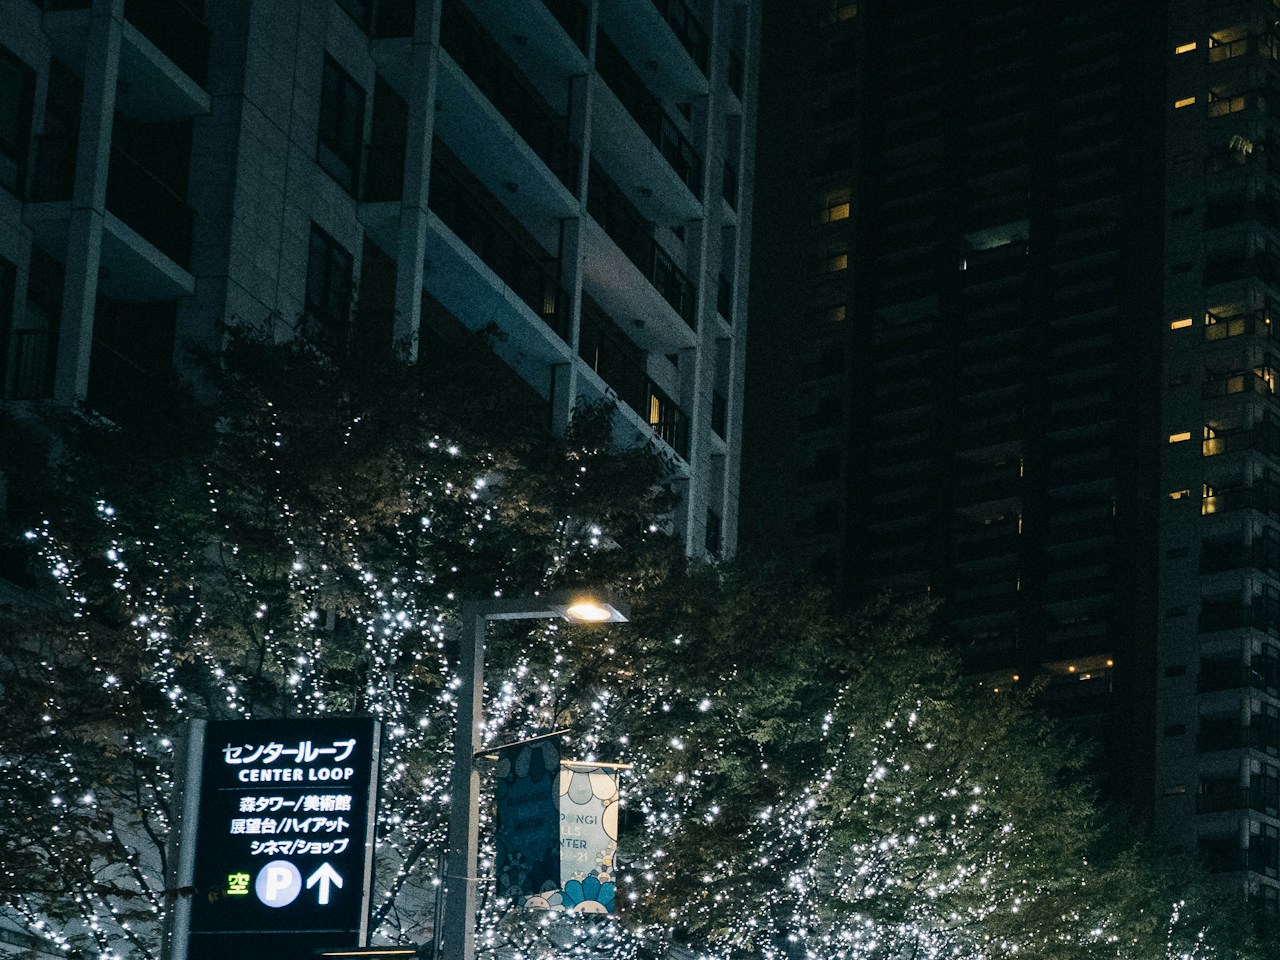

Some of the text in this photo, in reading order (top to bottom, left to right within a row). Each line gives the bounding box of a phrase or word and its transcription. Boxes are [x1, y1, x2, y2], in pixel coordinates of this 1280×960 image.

[222, 738, 356, 764] センターループ
[239, 767, 354, 782] CENTER LOOP
[239, 795, 352, 812] 森タワー/美術館
[230, 817, 350, 834] 展望台/ハイアット
[250, 838, 349, 855] シネマ/ショップ
[227, 867, 293, 901] 空 P
